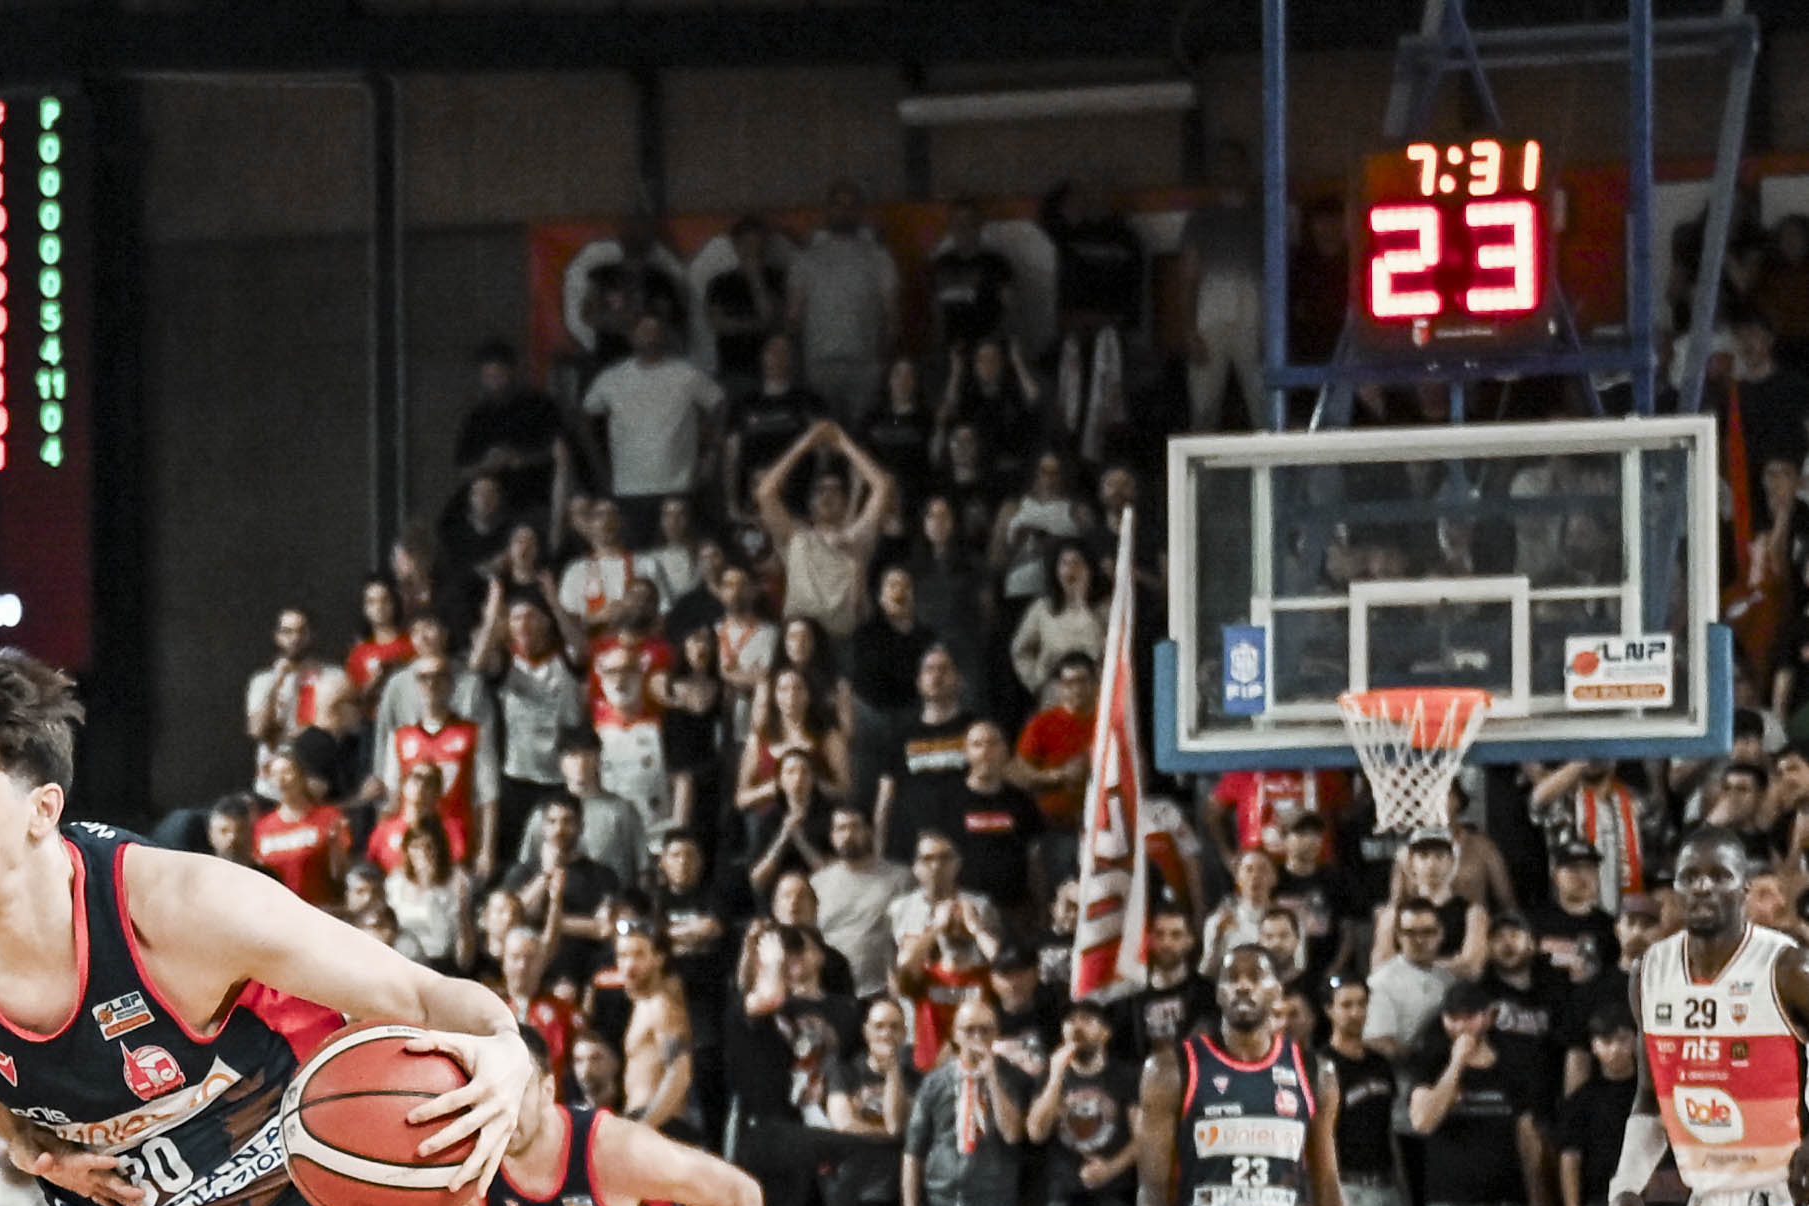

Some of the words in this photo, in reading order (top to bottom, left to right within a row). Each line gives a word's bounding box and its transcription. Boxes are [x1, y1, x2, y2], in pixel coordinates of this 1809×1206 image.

[39, 133, 60, 164] 0
[39, 167, 60, 197] 0
[1407, 140, 1540, 196] 7:31
[39, 201, 60, 231] 0
[39, 234, 61, 265] 0
[1370, 200, 1536, 316] 23
[40, 267, 61, 298] 0
[40, 301, 62, 332] 5
[40, 335, 62, 366] 4
[36, 368, 65, 400] 11
[40, 402, 63, 433] 0
[40, 436, 63, 467] 4
[1603, 642, 1666, 662] LNP
[1684, 998, 1717, 1030] 29
[1232, 1157, 1269, 1187] 23
